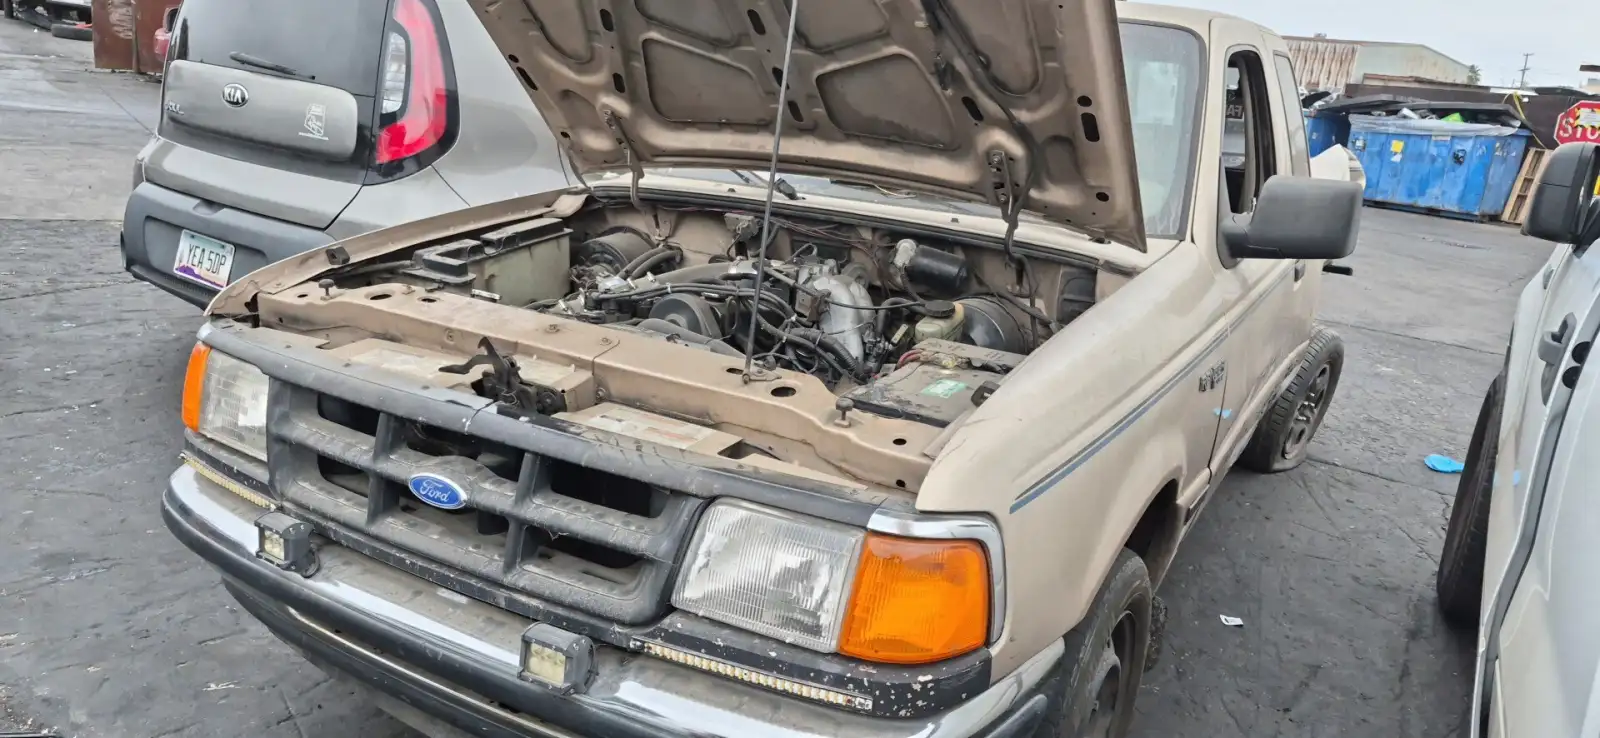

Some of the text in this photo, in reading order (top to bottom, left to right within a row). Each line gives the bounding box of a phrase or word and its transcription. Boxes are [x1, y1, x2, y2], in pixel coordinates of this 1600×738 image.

[224, 87, 242, 103] KIA
[1559, 117, 1600, 140] STO
[187, 243, 206, 270] YEA
[420, 479, 451, 502] Ford
